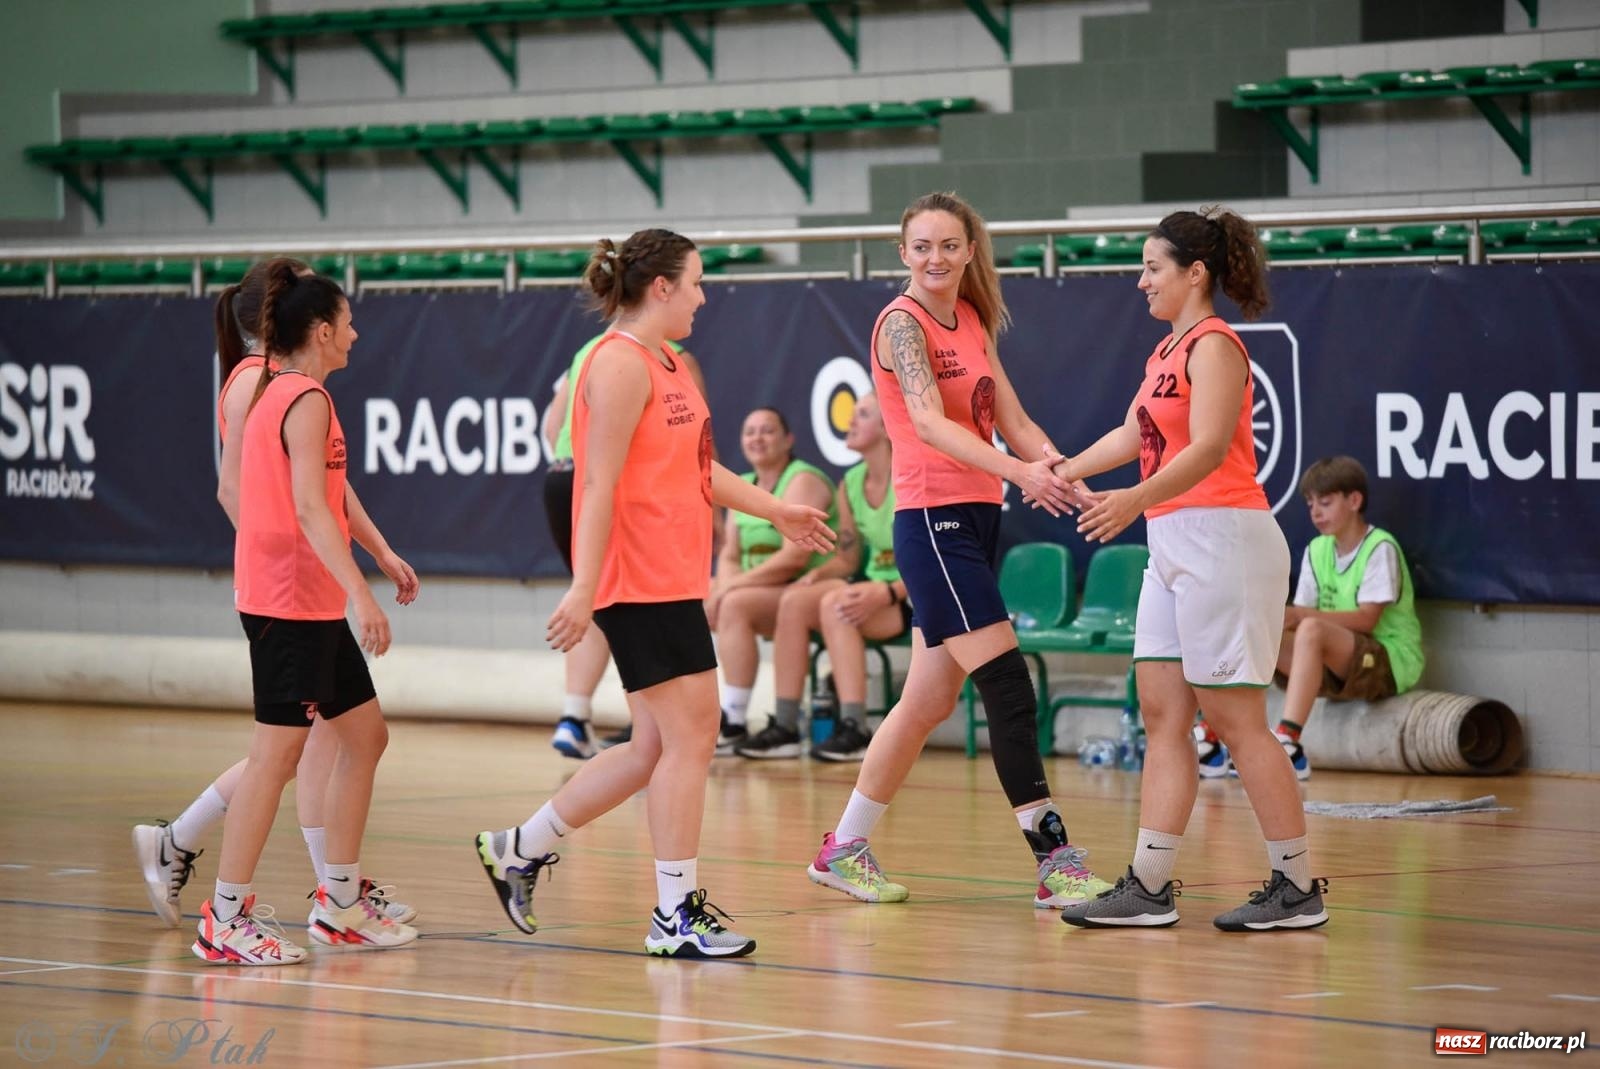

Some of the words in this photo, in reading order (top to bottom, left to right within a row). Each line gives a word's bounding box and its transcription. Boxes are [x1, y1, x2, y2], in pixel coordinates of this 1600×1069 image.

[937, 368, 968, 380] KOBIET
[1152, 373, 1179, 398] 22
[667, 413, 696, 426] KOBIET
[8, 463, 95, 499] RACIBÓRZ
